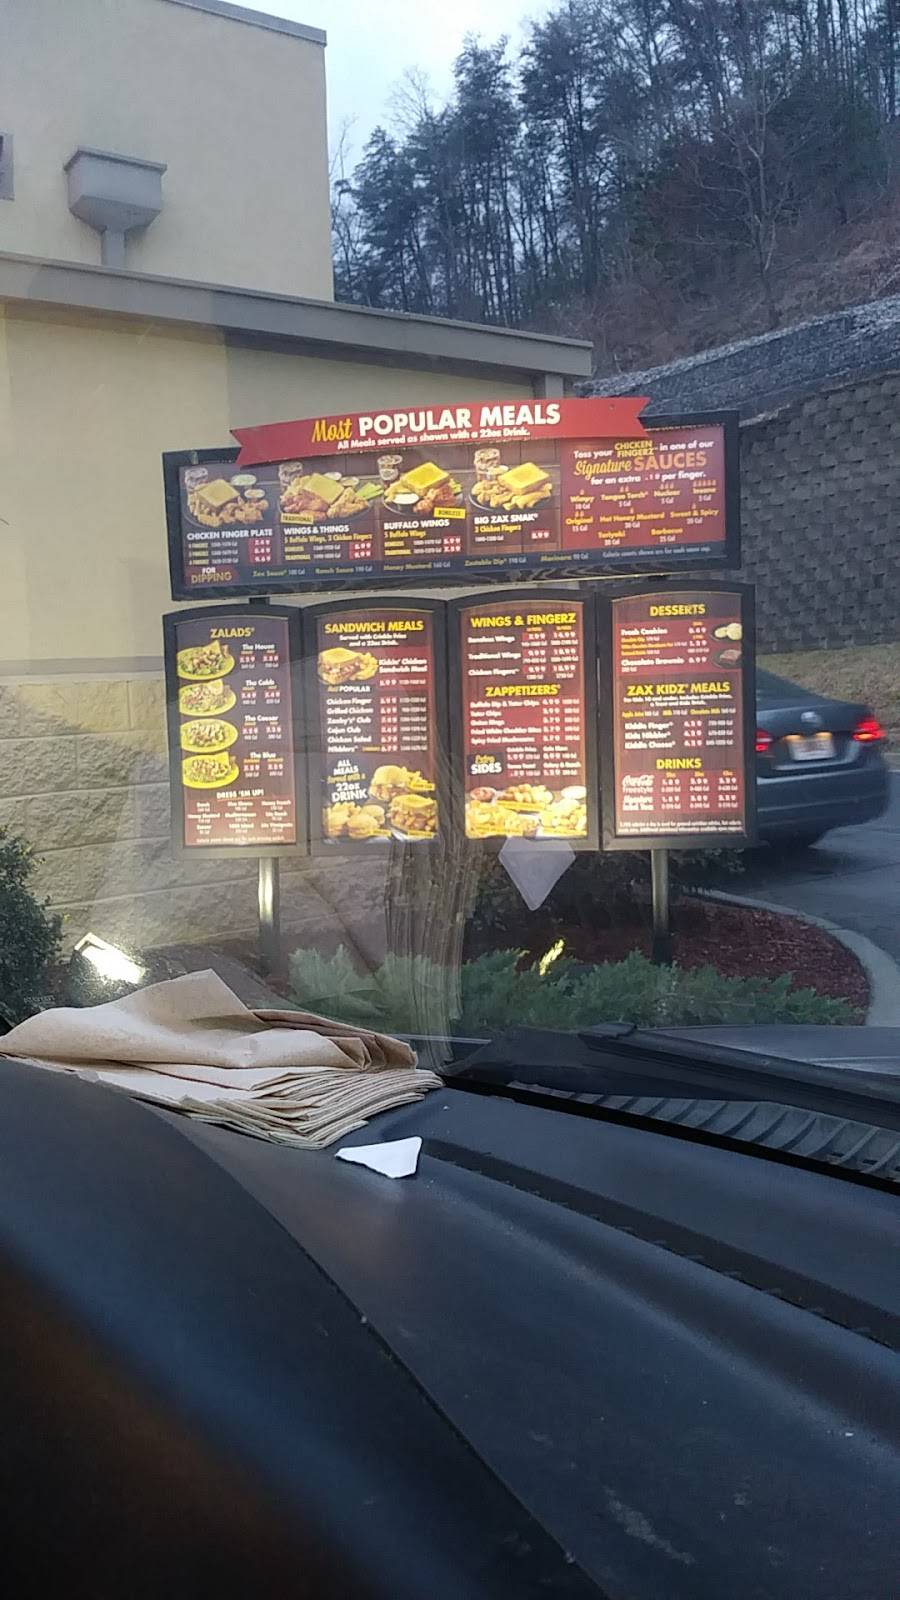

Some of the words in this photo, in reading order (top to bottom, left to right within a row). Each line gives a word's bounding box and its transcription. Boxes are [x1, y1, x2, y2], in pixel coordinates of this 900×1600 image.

[311, 418, 353, 443] Most
[358, 409, 472, 436] POPULAR
[479, 404, 560, 427] MEALS
[337, 440, 349, 450] All
[350, 439, 375, 448] Meals
[377, 435, 405, 445] served
[407, 435, 417, 443] as
[419, 432, 448, 442] shown
[450, 431, 470, 440] with
[479, 429, 501, 438] 22oz
[503, 427, 530, 436] Drink.
[615, 440, 652, 450] CHICKEN
[660, 443, 668, 451] in
[688, 441, 697, 449] of
[574, 450, 592, 459] Toss
[593, 449, 613, 459] your
[574, 459, 632, 480] Signature
[634, 451, 707, 471] SAUCES
[591, 476, 603, 485] for
[661, 474, 676, 482] per
[678, 471, 706, 479] finger.
[384, 521, 419, 530] BUFFALO
[421, 519, 450, 527] WINGS
[491, 515, 509, 523] ZAX
[566, 517, 593, 525] Original
[187, 530, 220, 540] CHICKEN
[222, 530, 249, 538] FINGER
[250, 528, 272, 536] PLATE
[320, 525, 349, 533] THINGS
[191, 571, 232, 584] DIPPING
[650, 604, 705, 616] DESSERTS
[471, 617, 512, 627] WINGS
[514, 616, 524, 626] &
[527, 613, 576, 625] FINGERZ
[325, 622, 385, 633] SANDWICH
[388, 621, 424, 631] MEALS
[210, 628, 251, 638] ZALADS
[485, 685, 558, 696] ZAPPETIZERS
[627, 685, 654, 696] ZAX
[656, 684, 686, 694] KIDZ
[691, 682, 730, 693] MEALS
[471, 763, 502, 774] SIDES
[656, 758, 701, 769] DRINKS
[334, 766, 359, 775] MEALS
[332, 789, 368, 802] DRINK
